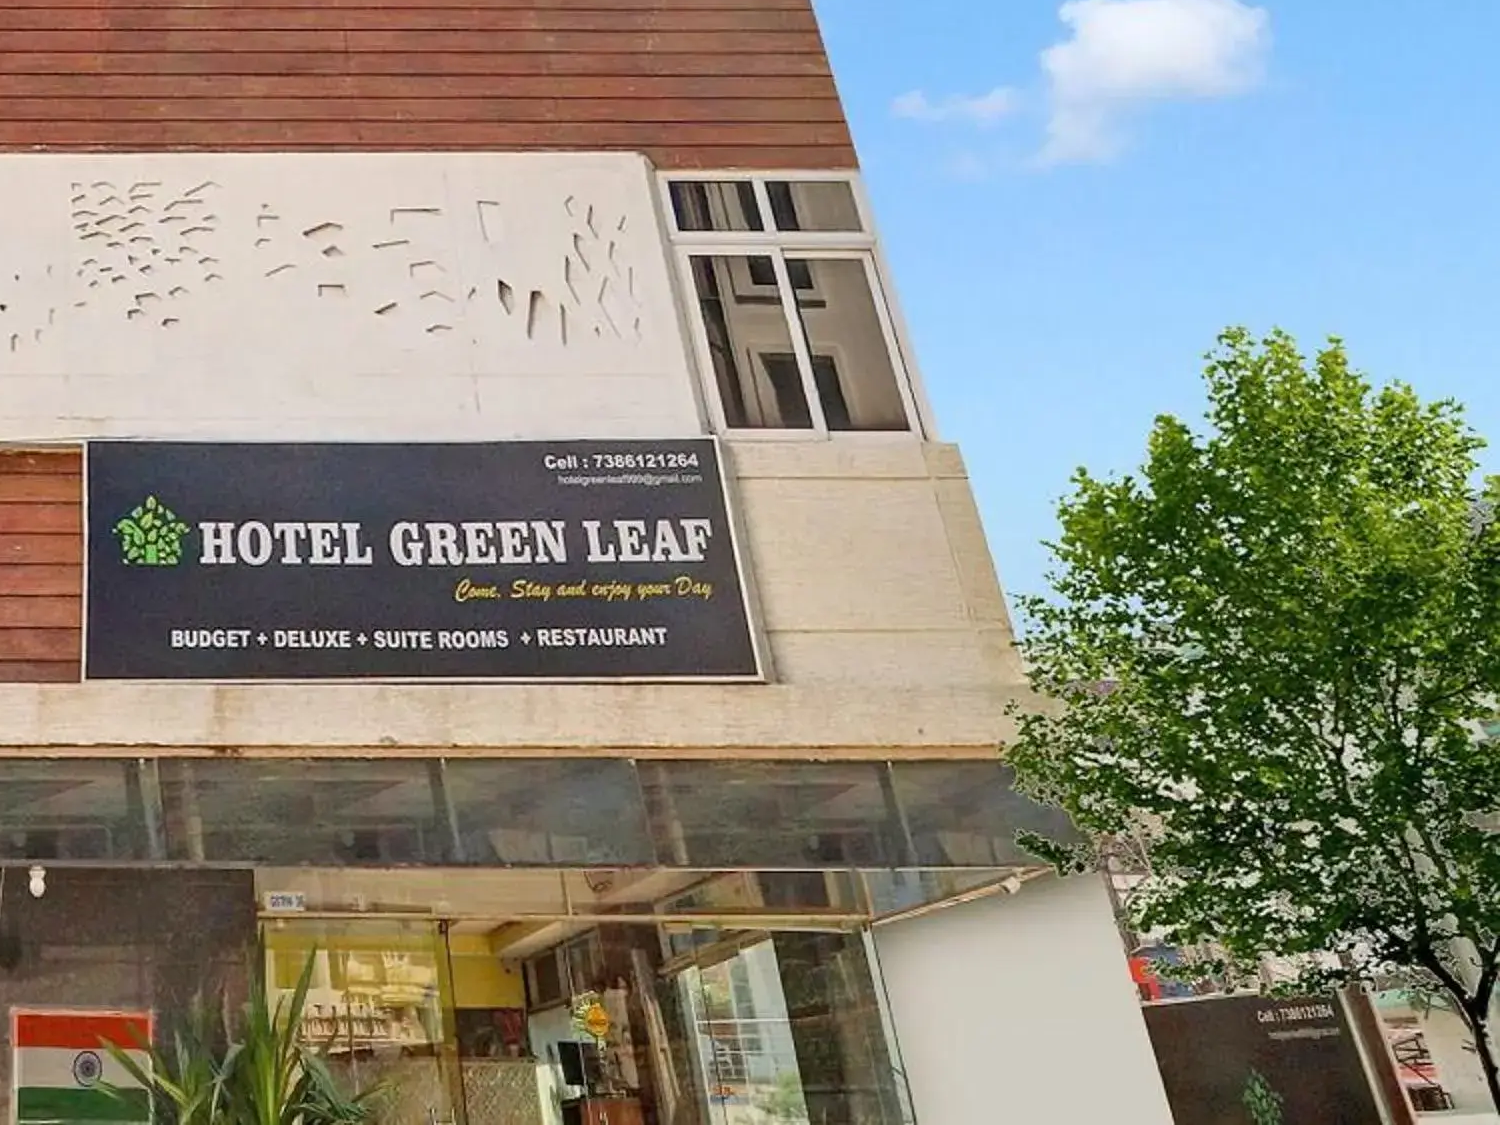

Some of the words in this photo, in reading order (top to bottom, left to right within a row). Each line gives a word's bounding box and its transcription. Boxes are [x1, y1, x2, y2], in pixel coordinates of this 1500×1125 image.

[544, 454, 579, 470] Cell
[592, 452, 699, 469] 7386121264
[198, 520, 373, 566] HOTEL
[390, 520, 567, 566] GREEN
[582, 518, 713, 563] LEAF
[510, 579, 552, 602] Stay
[556, 579, 587, 597] and
[591, 580, 632, 602] enjoy
[637, 582, 672, 602] your
[675, 576, 713, 600] Day
[171, 629, 251, 648] BUDGET
[273, 630, 352, 648] DELUXE
[373, 630, 433, 649] SUITE
[438, 630, 509, 649] ROOMS
[537, 627, 667, 647] RESTAURANT
